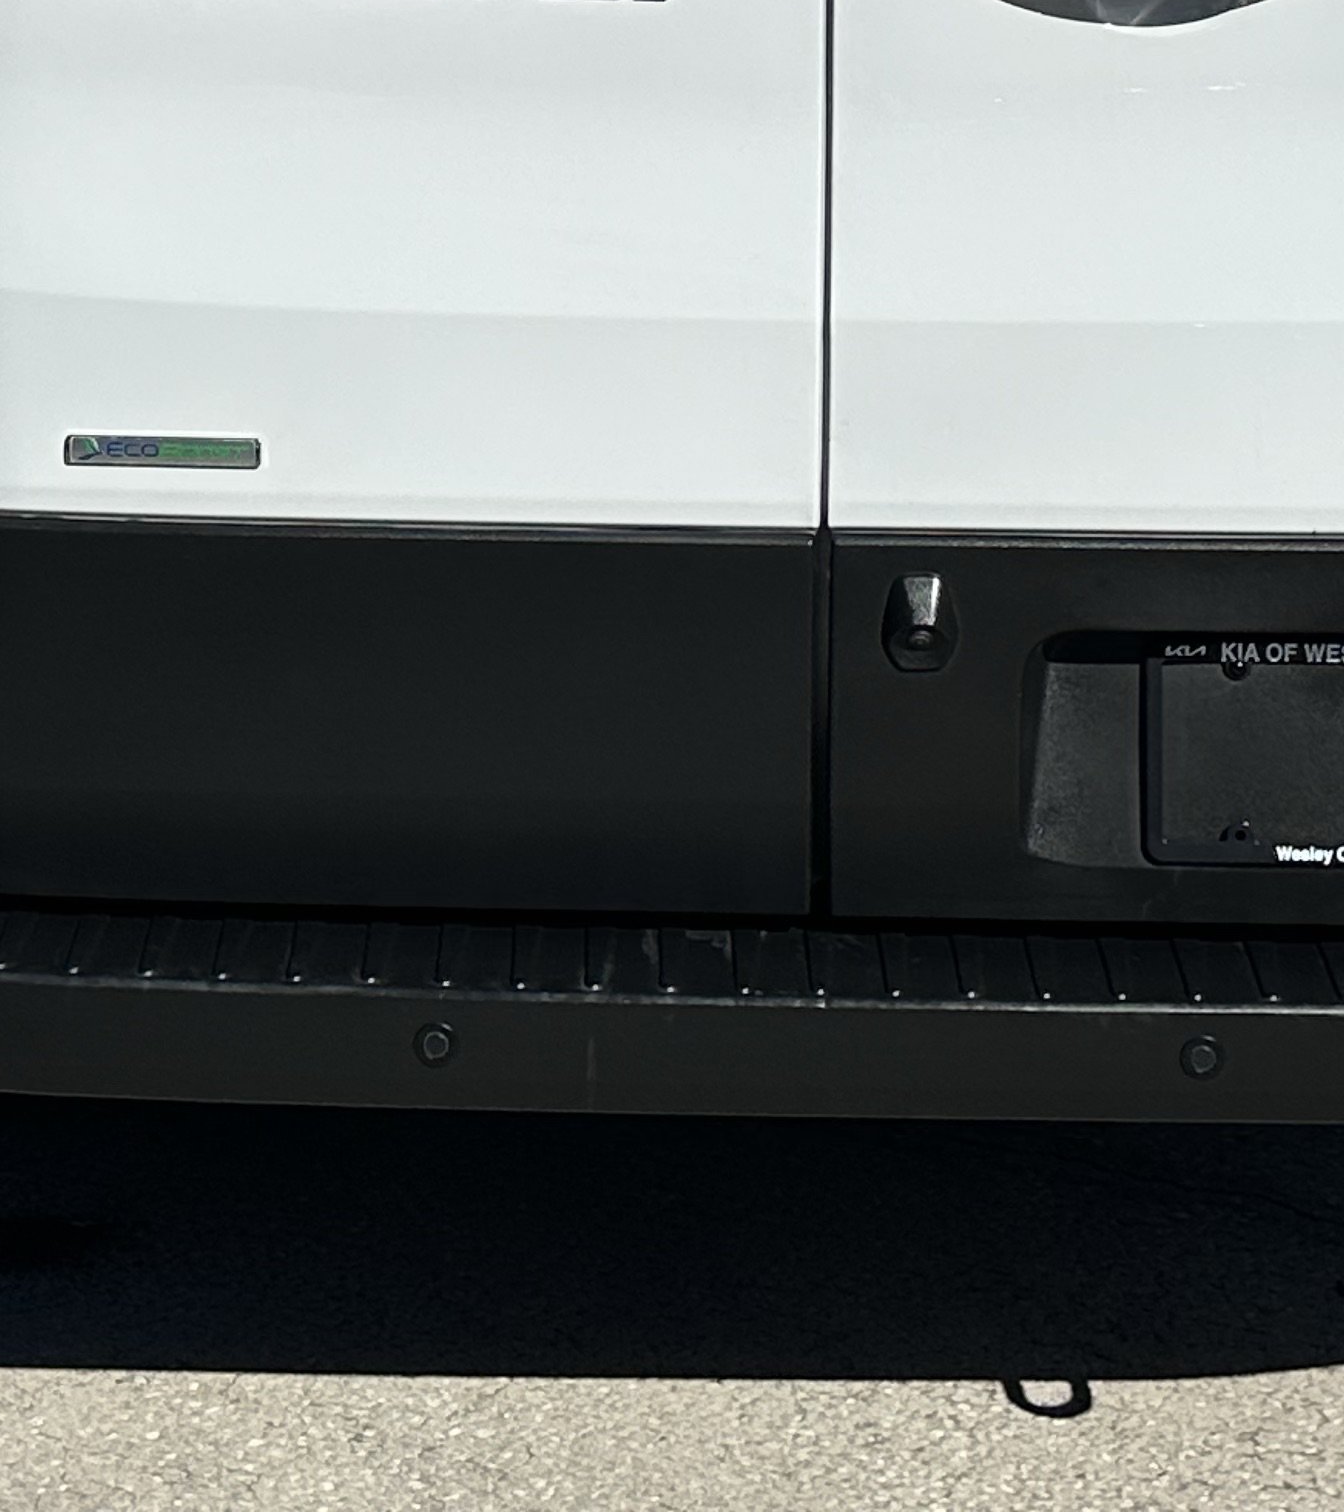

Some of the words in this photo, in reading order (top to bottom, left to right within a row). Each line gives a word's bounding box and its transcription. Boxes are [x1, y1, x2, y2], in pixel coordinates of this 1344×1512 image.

[1221, 642, 1261, 663] KIA
[1265, 643, 1298, 663] OF
[1274, 845, 1334, 866] Wesley
